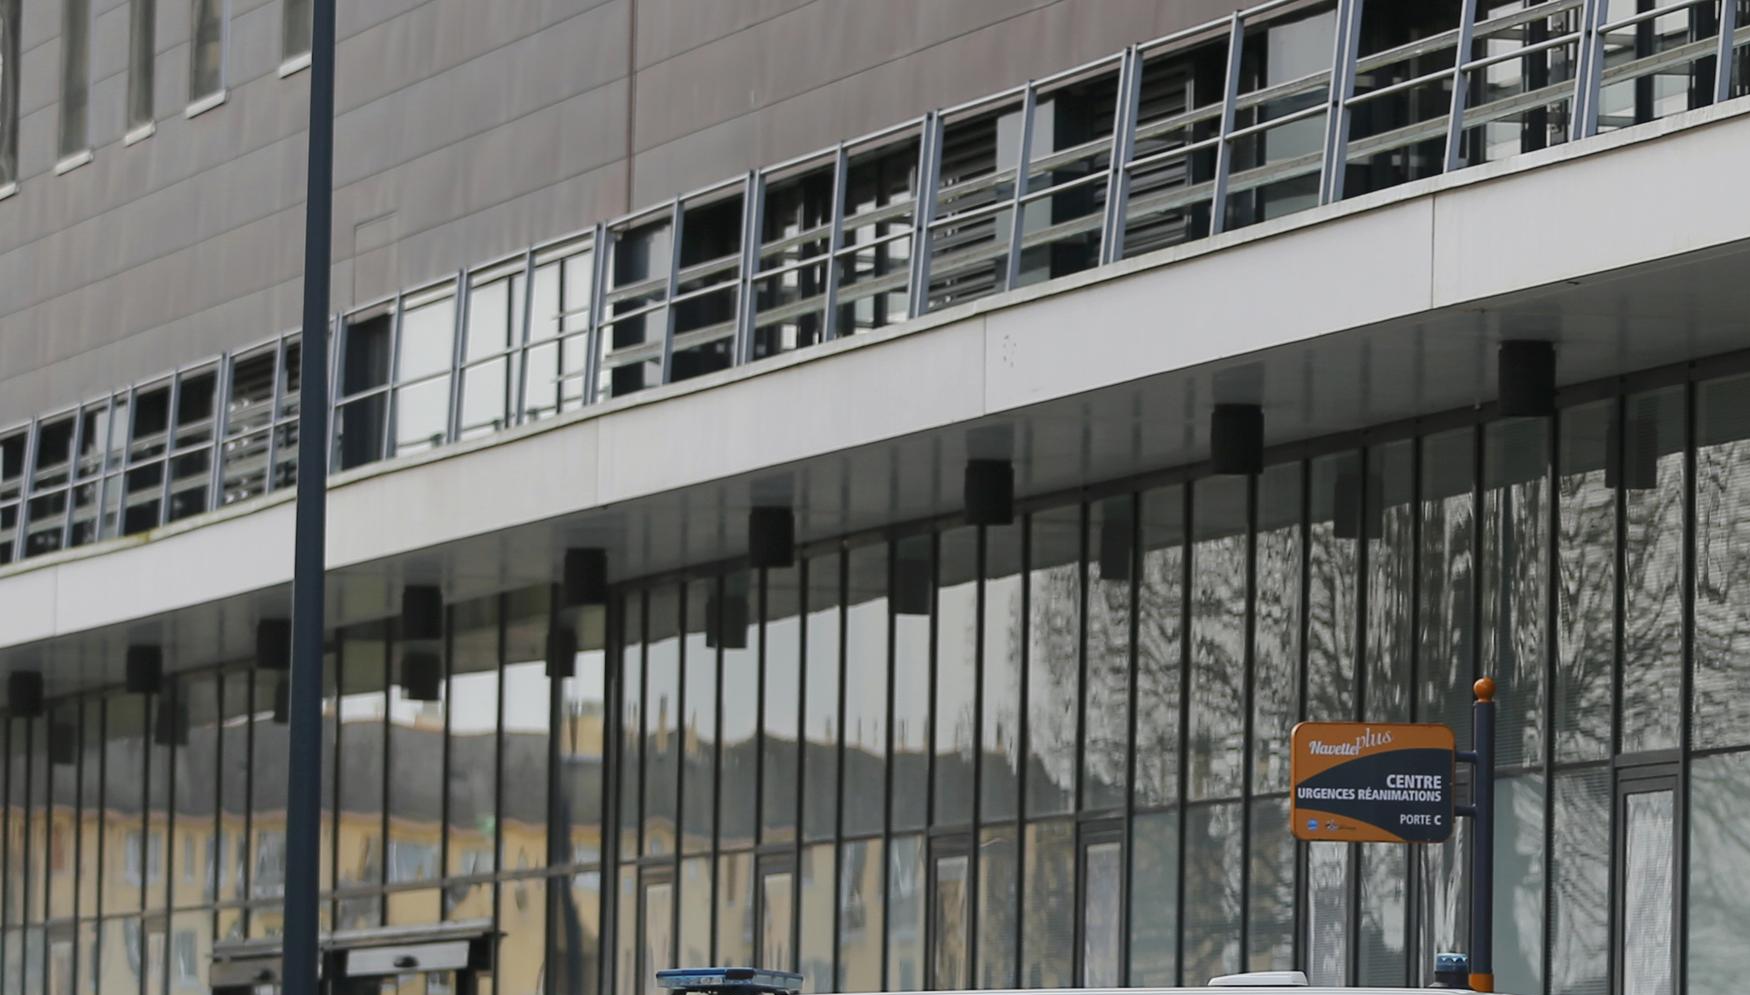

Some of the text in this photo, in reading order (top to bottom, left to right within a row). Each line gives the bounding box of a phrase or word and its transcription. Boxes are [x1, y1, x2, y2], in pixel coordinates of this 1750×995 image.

[1356, 727, 1393, 749] plus
[1386, 774, 1442, 789] CENTRE
[1297, 786, 1442, 802] URGENCES RÉANIMATIONS
[1400, 814, 1442, 825] PORTE C
